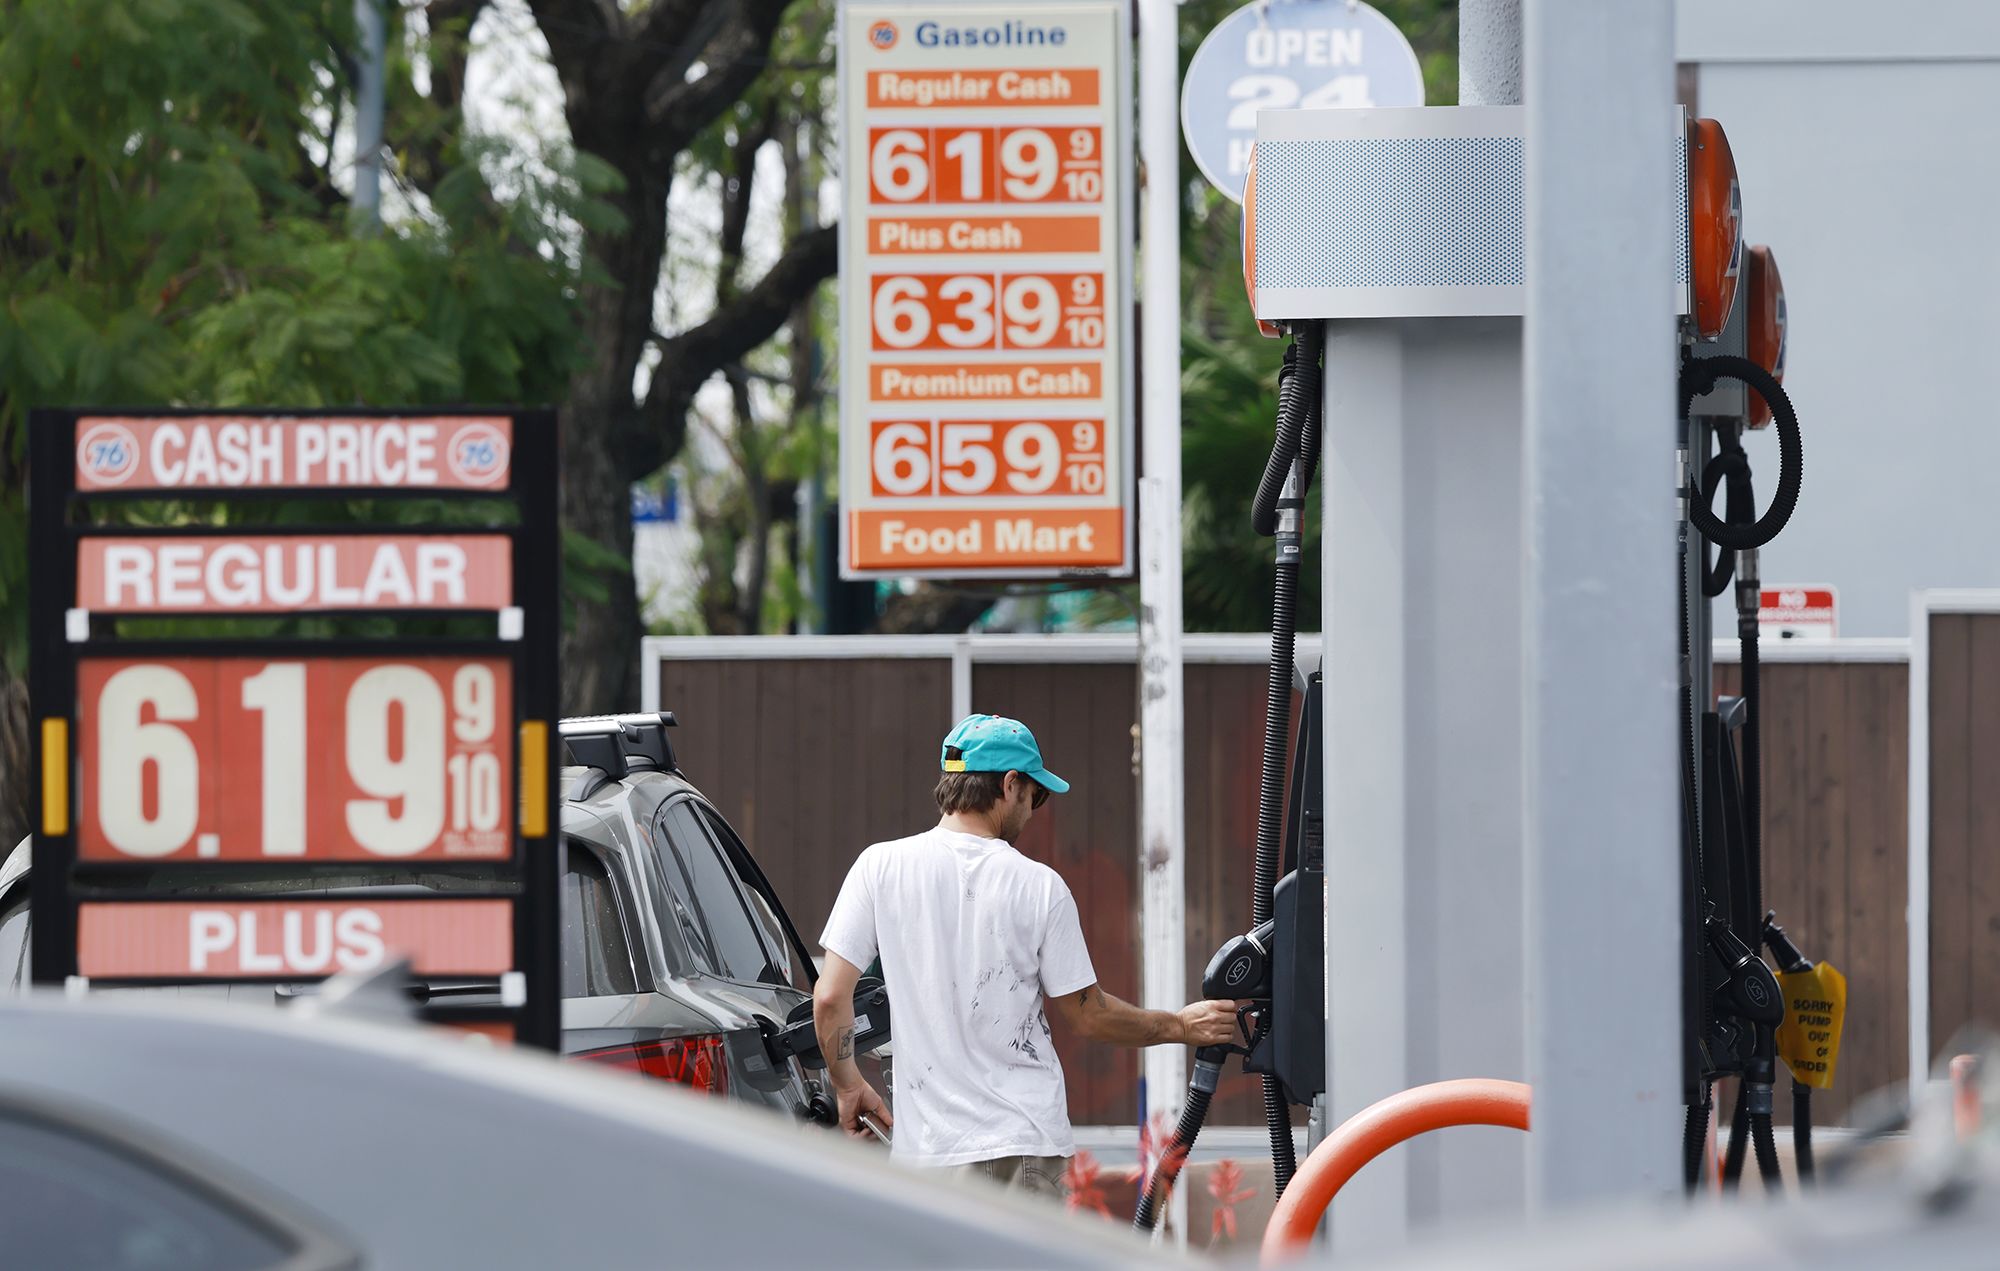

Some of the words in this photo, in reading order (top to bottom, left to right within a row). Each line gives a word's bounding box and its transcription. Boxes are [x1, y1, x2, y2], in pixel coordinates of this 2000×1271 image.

[916, 20, 1068, 48] Gasoline
[1246, 28, 1363, 67] OPEN
[878, 73, 992, 105] Regular
[997, 71, 1072, 99] Cash
[871, 128, 1059, 202] 619
[879, 222, 943, 249] Plus
[948, 221, 1022, 249] Cash
[873, 275, 1061, 348] 639
[881, 368, 1013, 396] Premium
[1018, 367, 1091, 395] Cash
[150, 423, 283, 486] CASH
[296, 422, 438, 485] PRICE
[873, 422, 1062, 495] 659
[880, 520, 982, 555] Food
[995, 519, 1094, 552] Mart
[104, 542, 468, 605] REGULAR
[189, 909, 386, 973] PLUS
[1793, 1000, 1834, 1012] SORRY
[1798, 1014, 1831, 1026] PUMP
[1808, 1031, 1830, 1042] OUT
